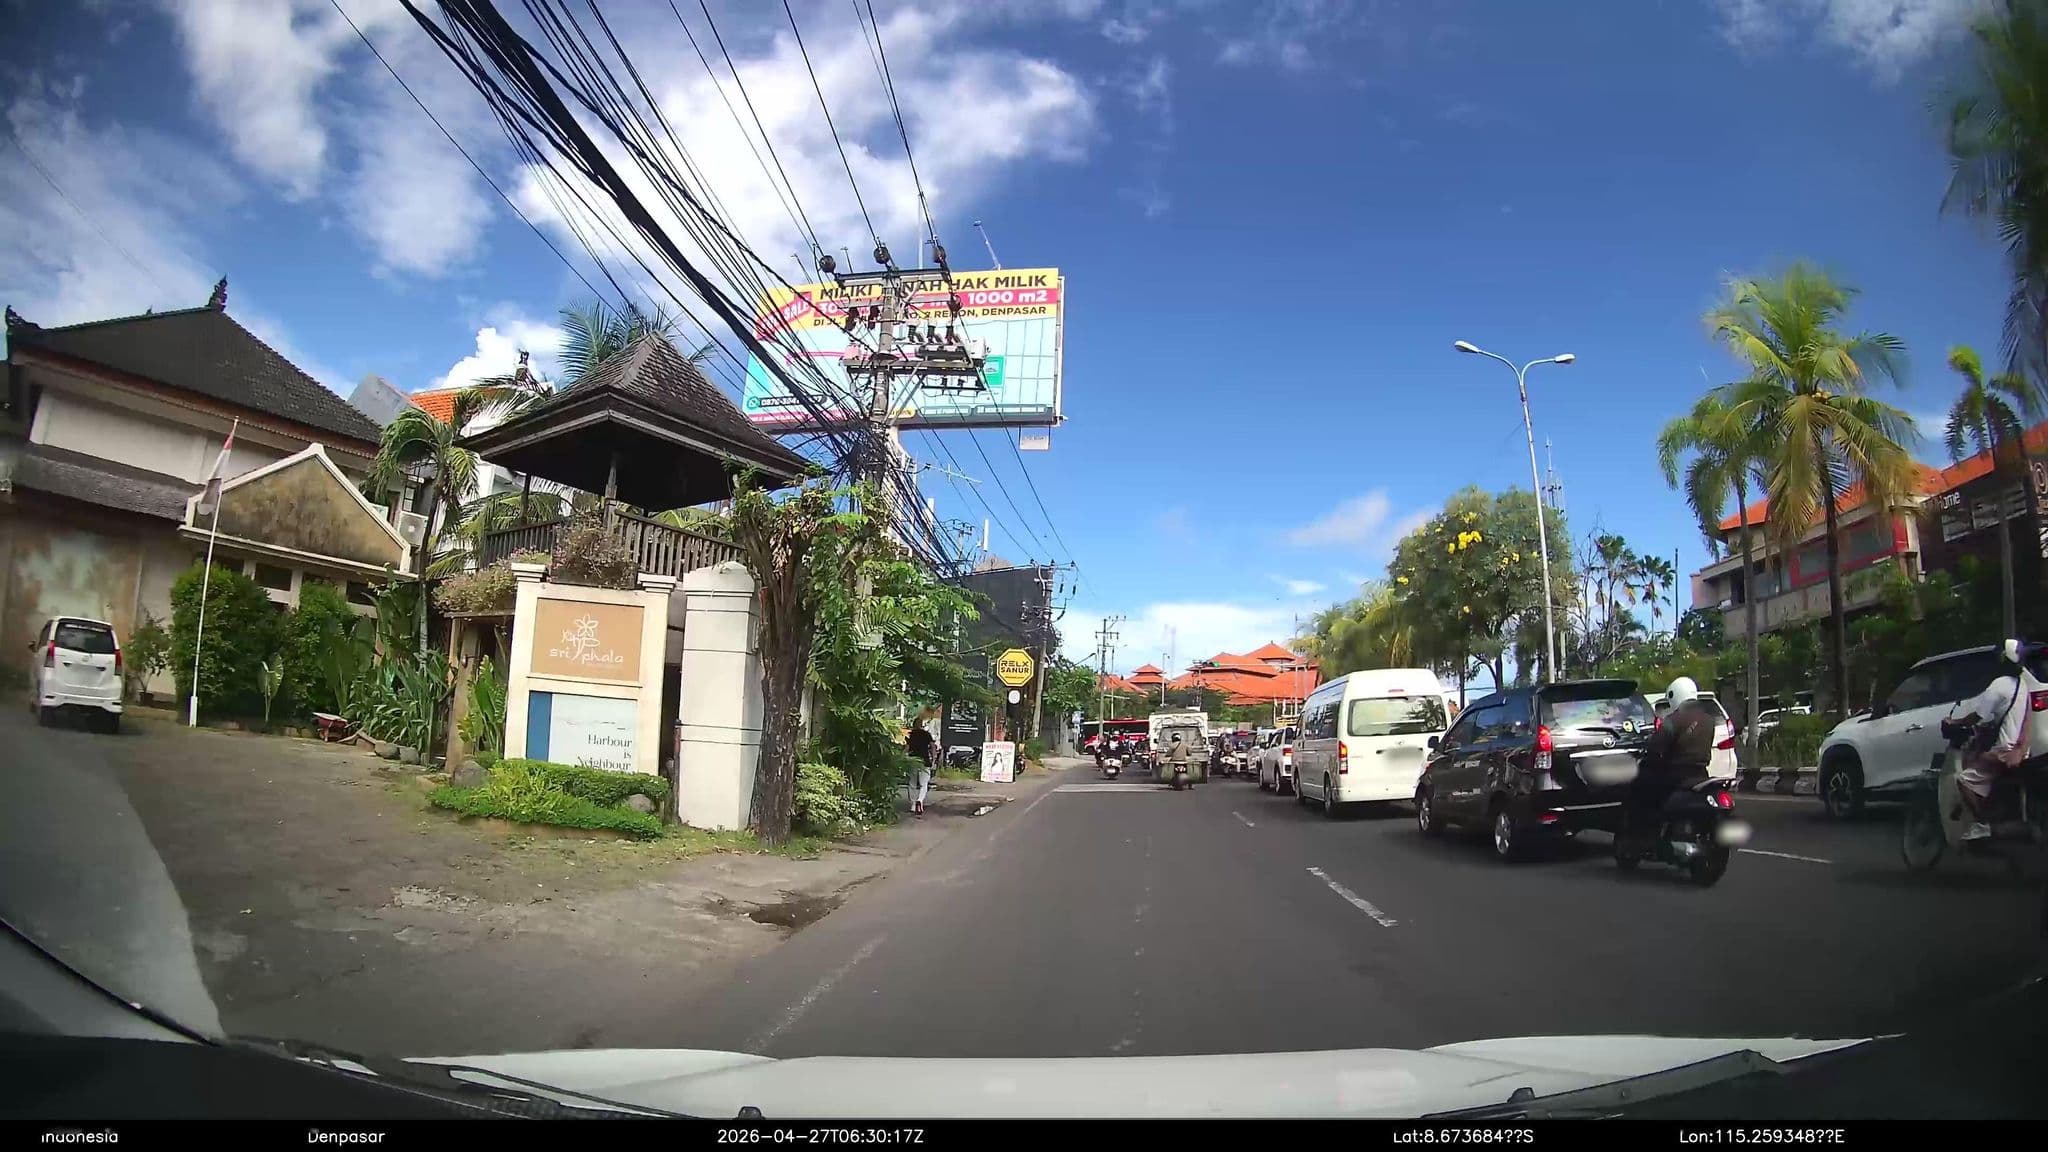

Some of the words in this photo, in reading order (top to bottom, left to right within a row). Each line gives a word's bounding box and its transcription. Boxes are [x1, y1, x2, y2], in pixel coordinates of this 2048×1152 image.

[820, 284, 873, 300] MILIKI
[994, 275, 1047, 288] MILIK
[968, 291, 1013, 306] 1000
[1018, 290, 1048, 303] m2
[982, 306, 1047, 316] DENPASAR
[550, 646, 570, 659] sri
[582, 648, 624, 665] phala
[1000, 660, 1030, 668] RELX
[1000, 666, 1030, 674] SANUR
[588, 734, 632, 748] Harbour
[623, 749, 632, 760] is
